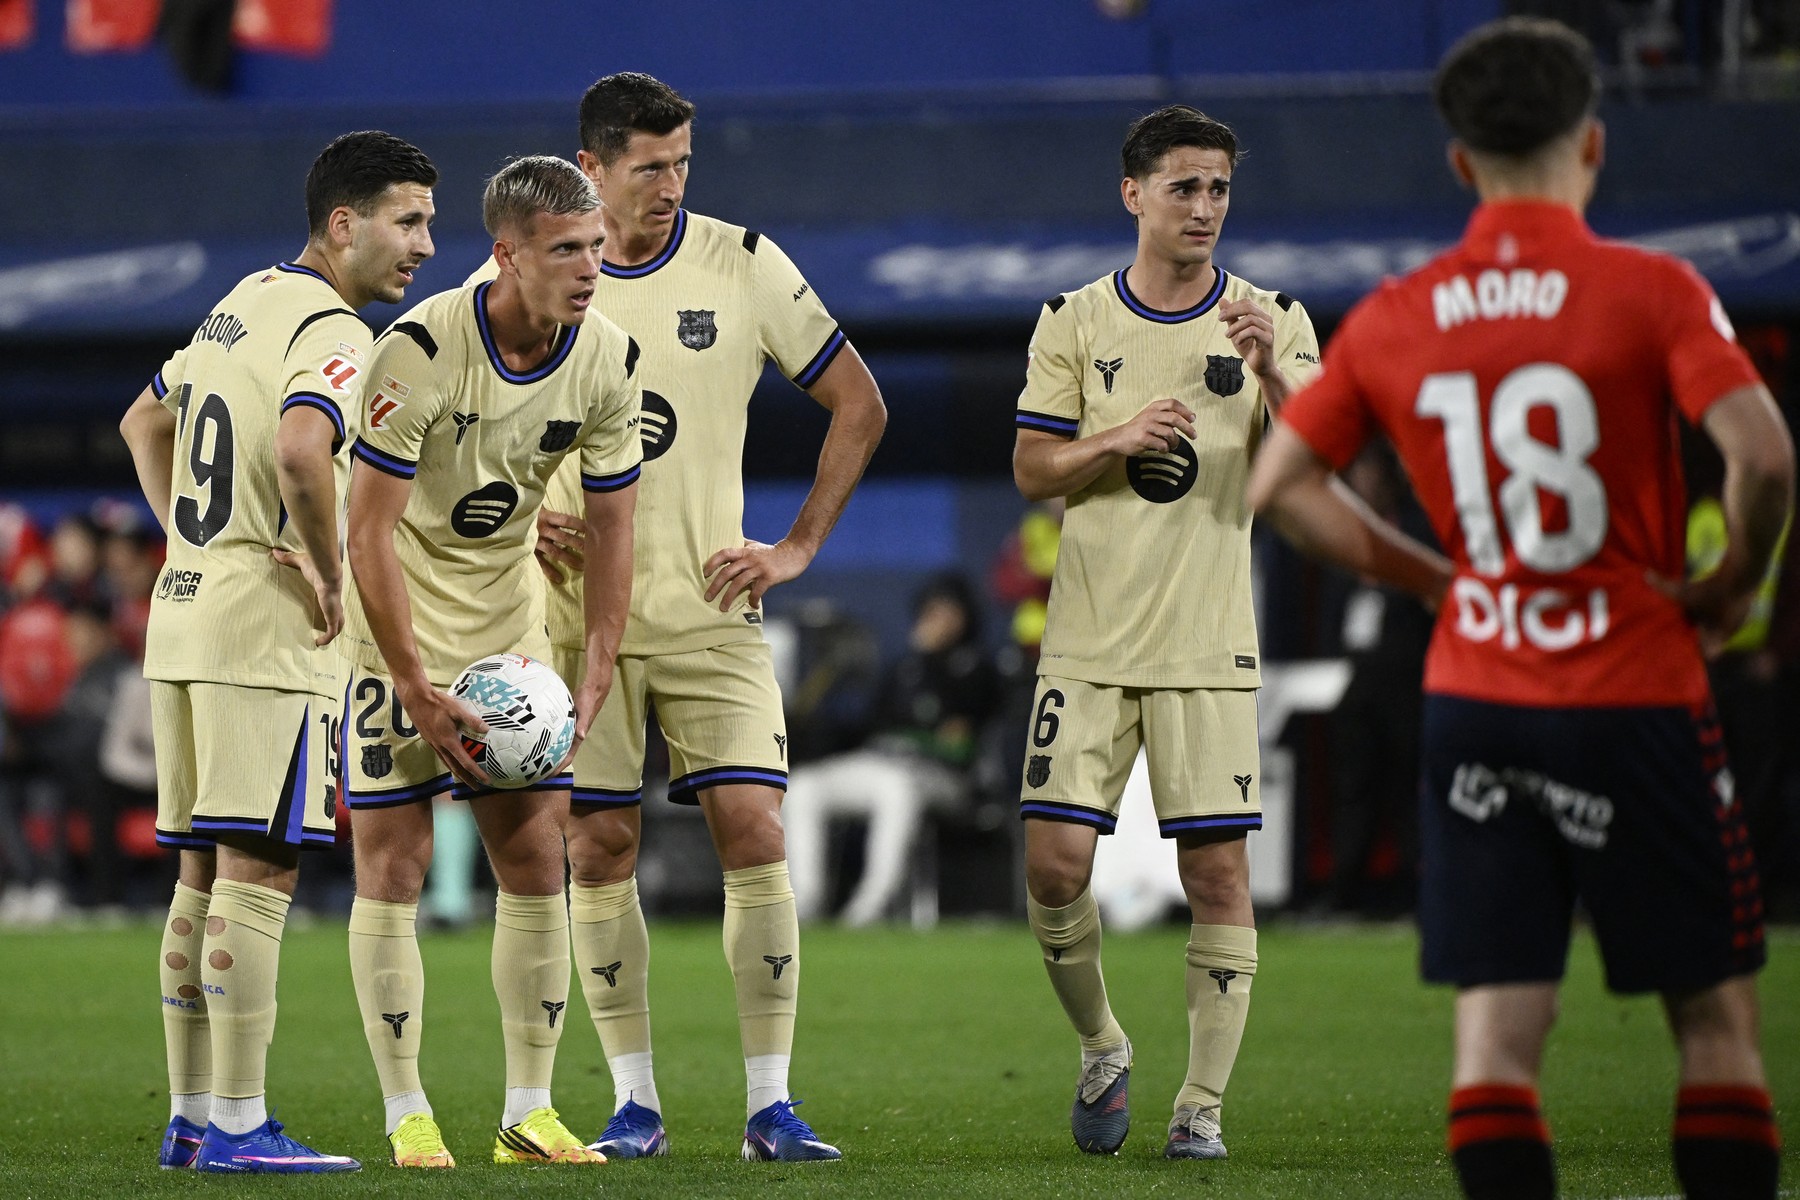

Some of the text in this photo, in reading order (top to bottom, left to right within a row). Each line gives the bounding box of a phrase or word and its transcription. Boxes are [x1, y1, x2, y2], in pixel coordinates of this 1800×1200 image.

[1432, 269, 1568, 332] MORO
[1415, 362, 1609, 578] 18
[356, 677, 420, 738] 20
[1033, 688, 1065, 748] 6
